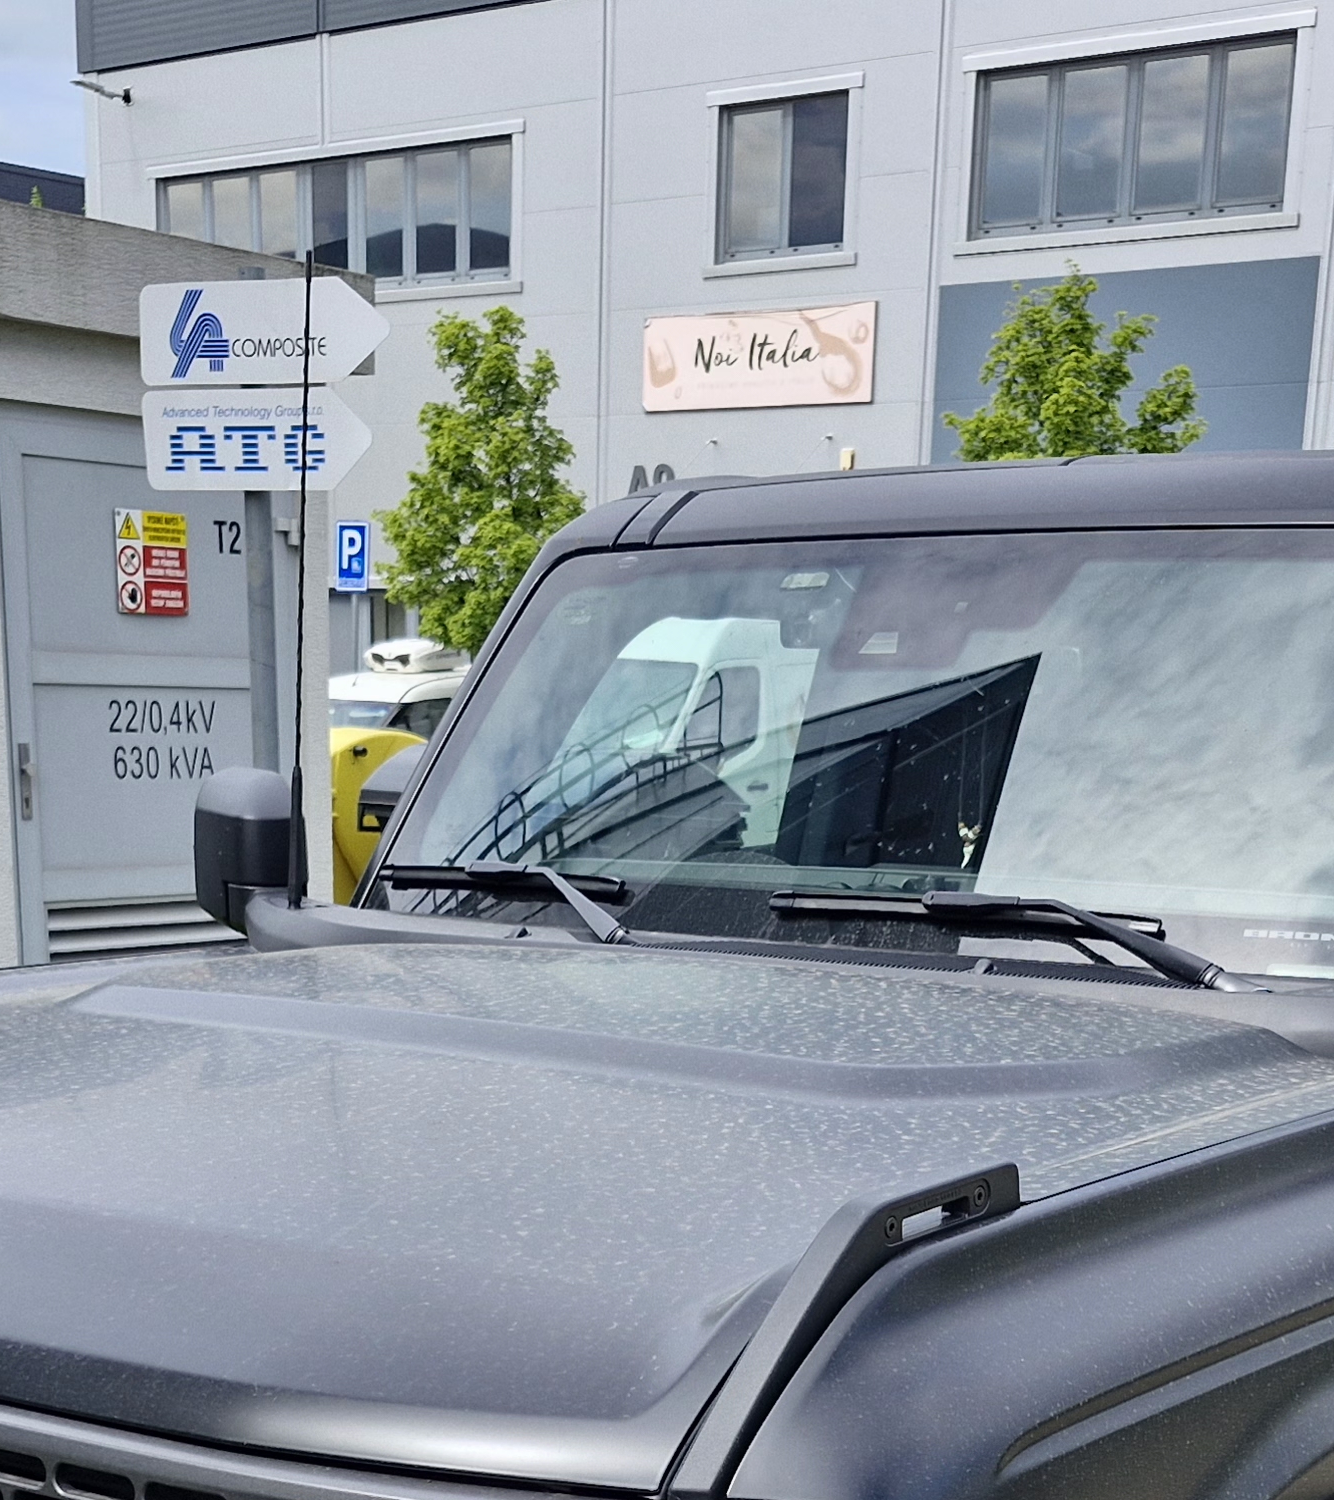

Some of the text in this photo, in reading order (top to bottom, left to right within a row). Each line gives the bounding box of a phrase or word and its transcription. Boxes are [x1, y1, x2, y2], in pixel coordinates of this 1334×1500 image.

[231, 336, 327, 358] COMPOSTE
[694, 328, 820, 374] Noi Italia
[161, 405, 209, 419] Advanced
[212, 404, 273, 421] Technology
[274, 403, 304, 420] Group
[213, 520, 242, 555] T2
[341, 529, 362, 570] P
[113, 746, 215, 780] 630 kVA
